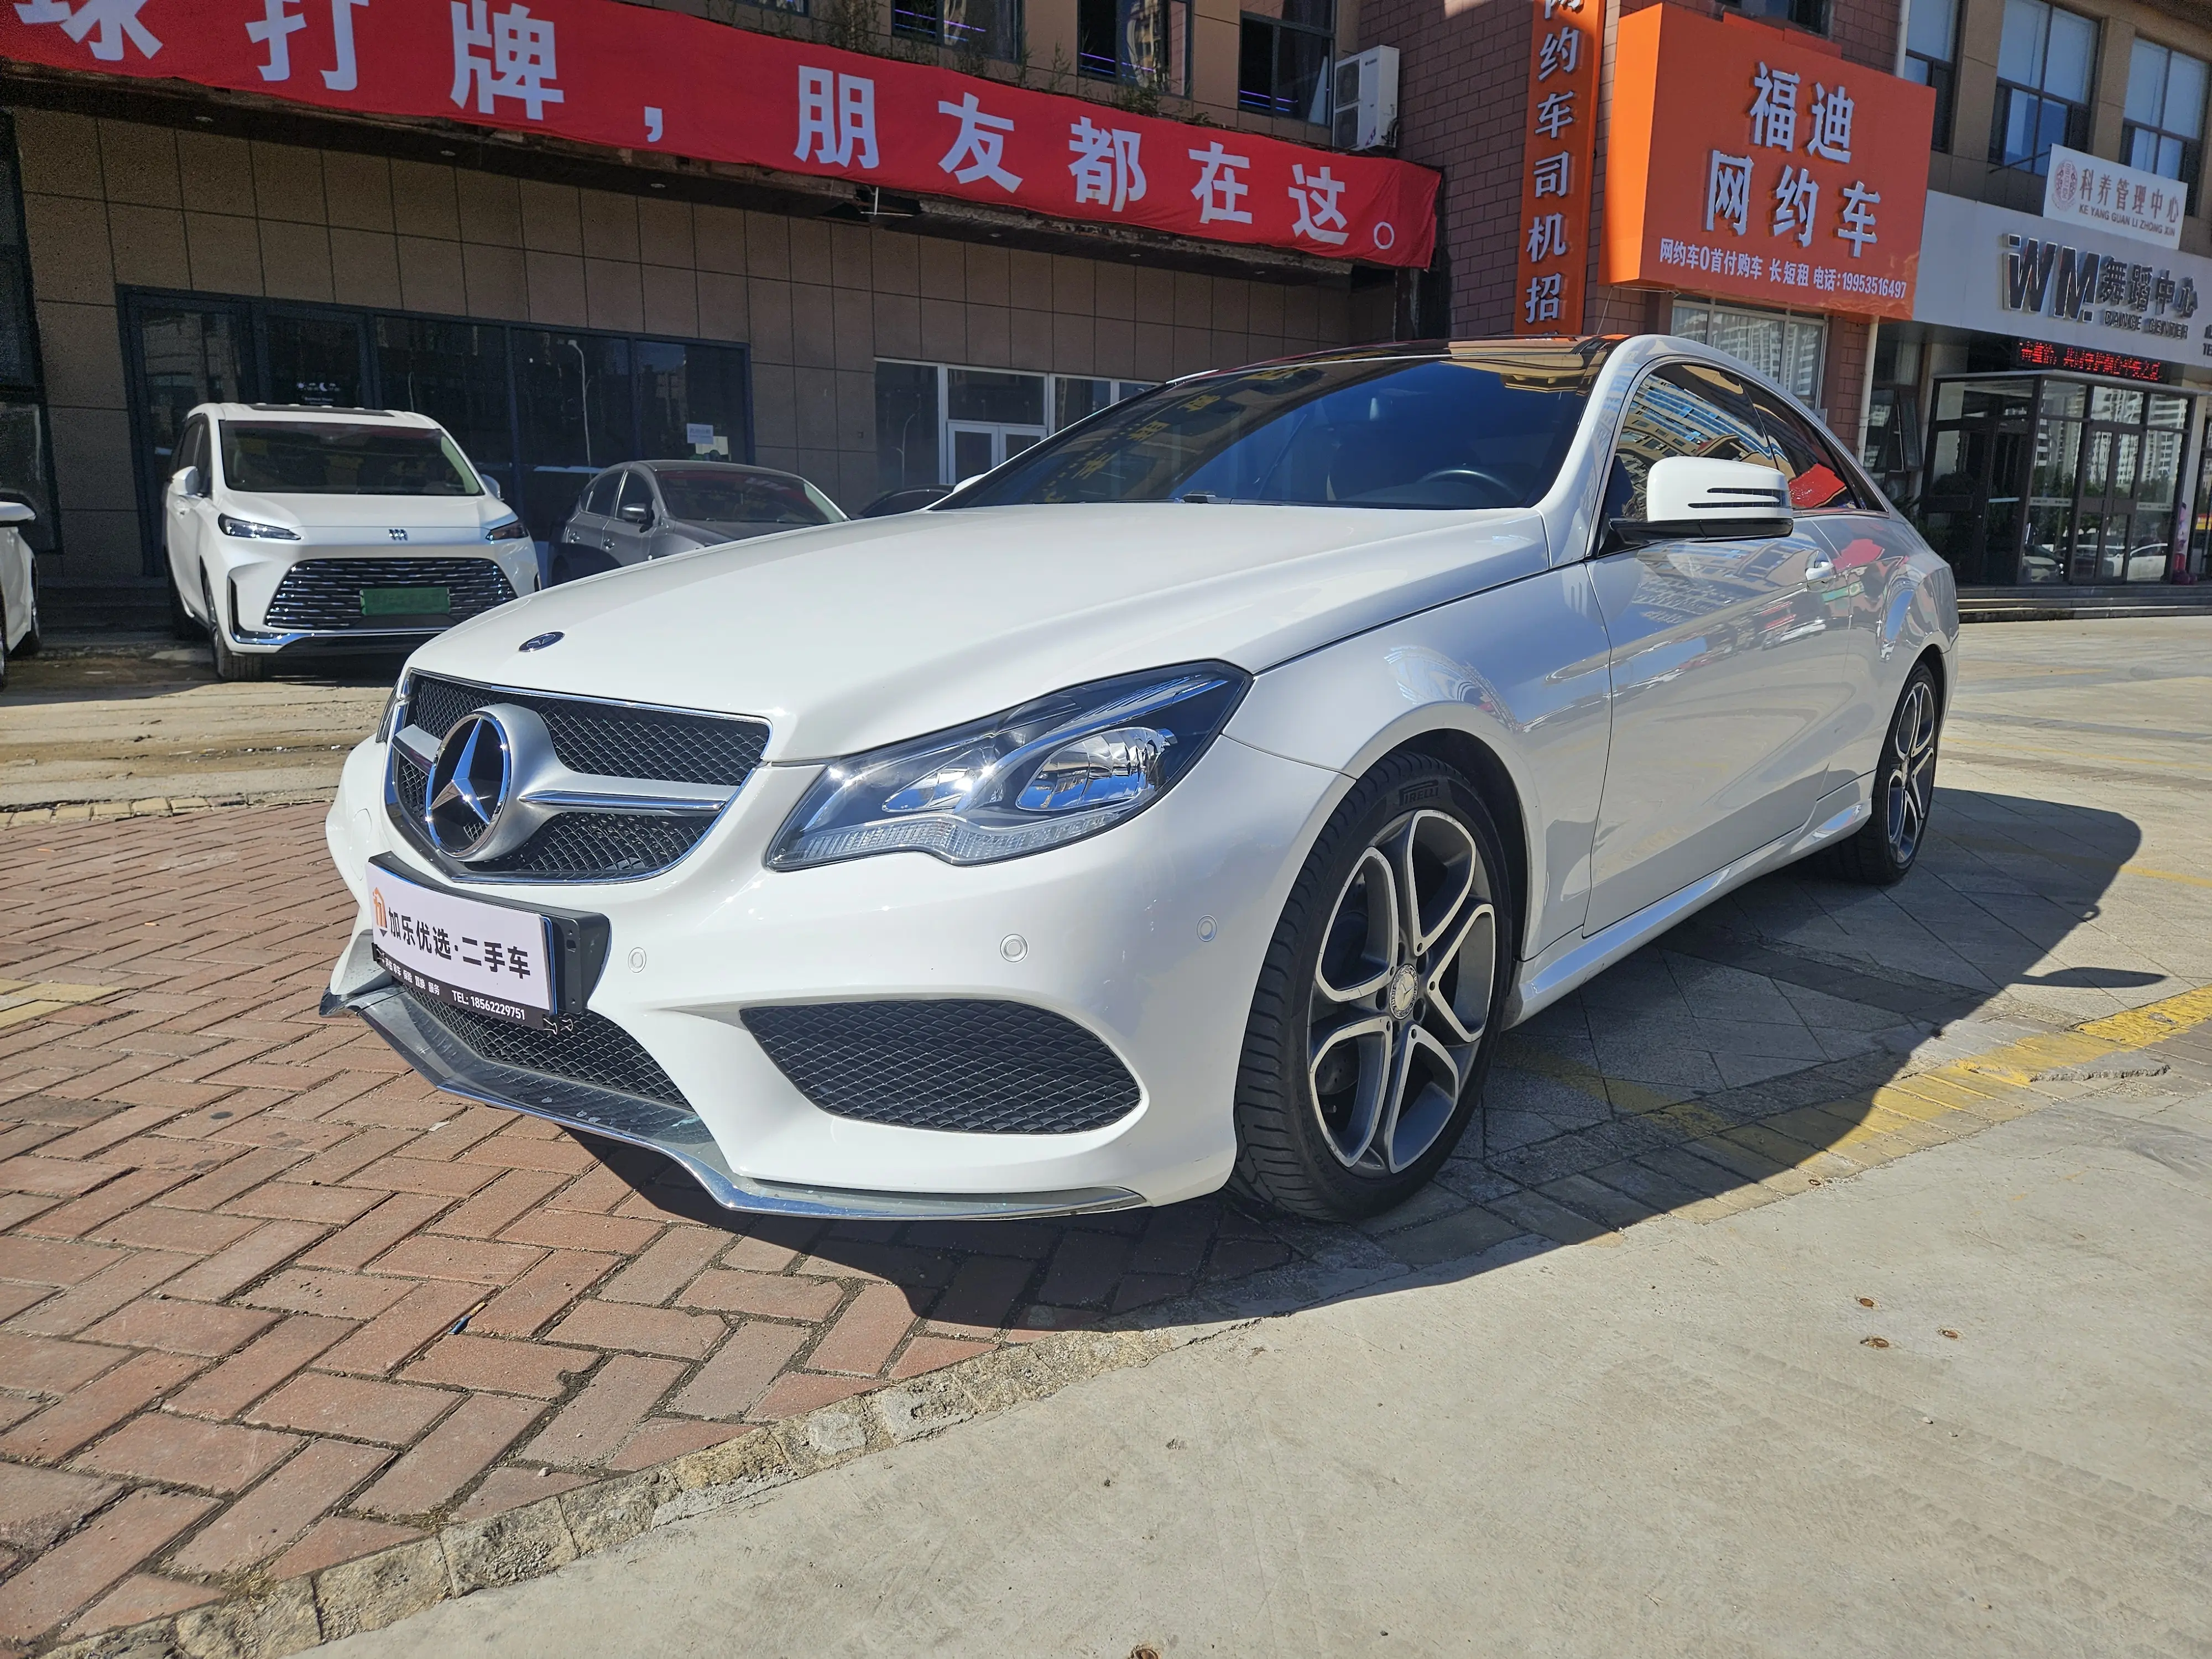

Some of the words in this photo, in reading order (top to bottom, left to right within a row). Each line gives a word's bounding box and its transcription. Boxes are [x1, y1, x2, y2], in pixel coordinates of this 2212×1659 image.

[1750, 61, 1855, 164] 福迪
[1705, 149, 1881, 258] 网约车
[2079, 168, 2179, 223] 科养管理中心
[2079, 203, 2089, 215] KE
[2090, 206, 2110, 221] YANG
[2111, 211, 2131, 226] GUAN
[2131, 218, 2138, 228] LI
[2139, 219, 2163, 234] ZHONG
[2164, 226, 2176, 237] XIN
[1770, 258, 1809, 287] 长短租
[2101, 255, 2198, 318] 舞蹈中心
[2104, 310, 2142, 332] DANCE
[2148, 317, 2189, 340] CENTER
[428, 981, 440, 996] 服务
[451, 989, 469, 1005] TEL:
[469, 996, 526, 1020] 18562229751
